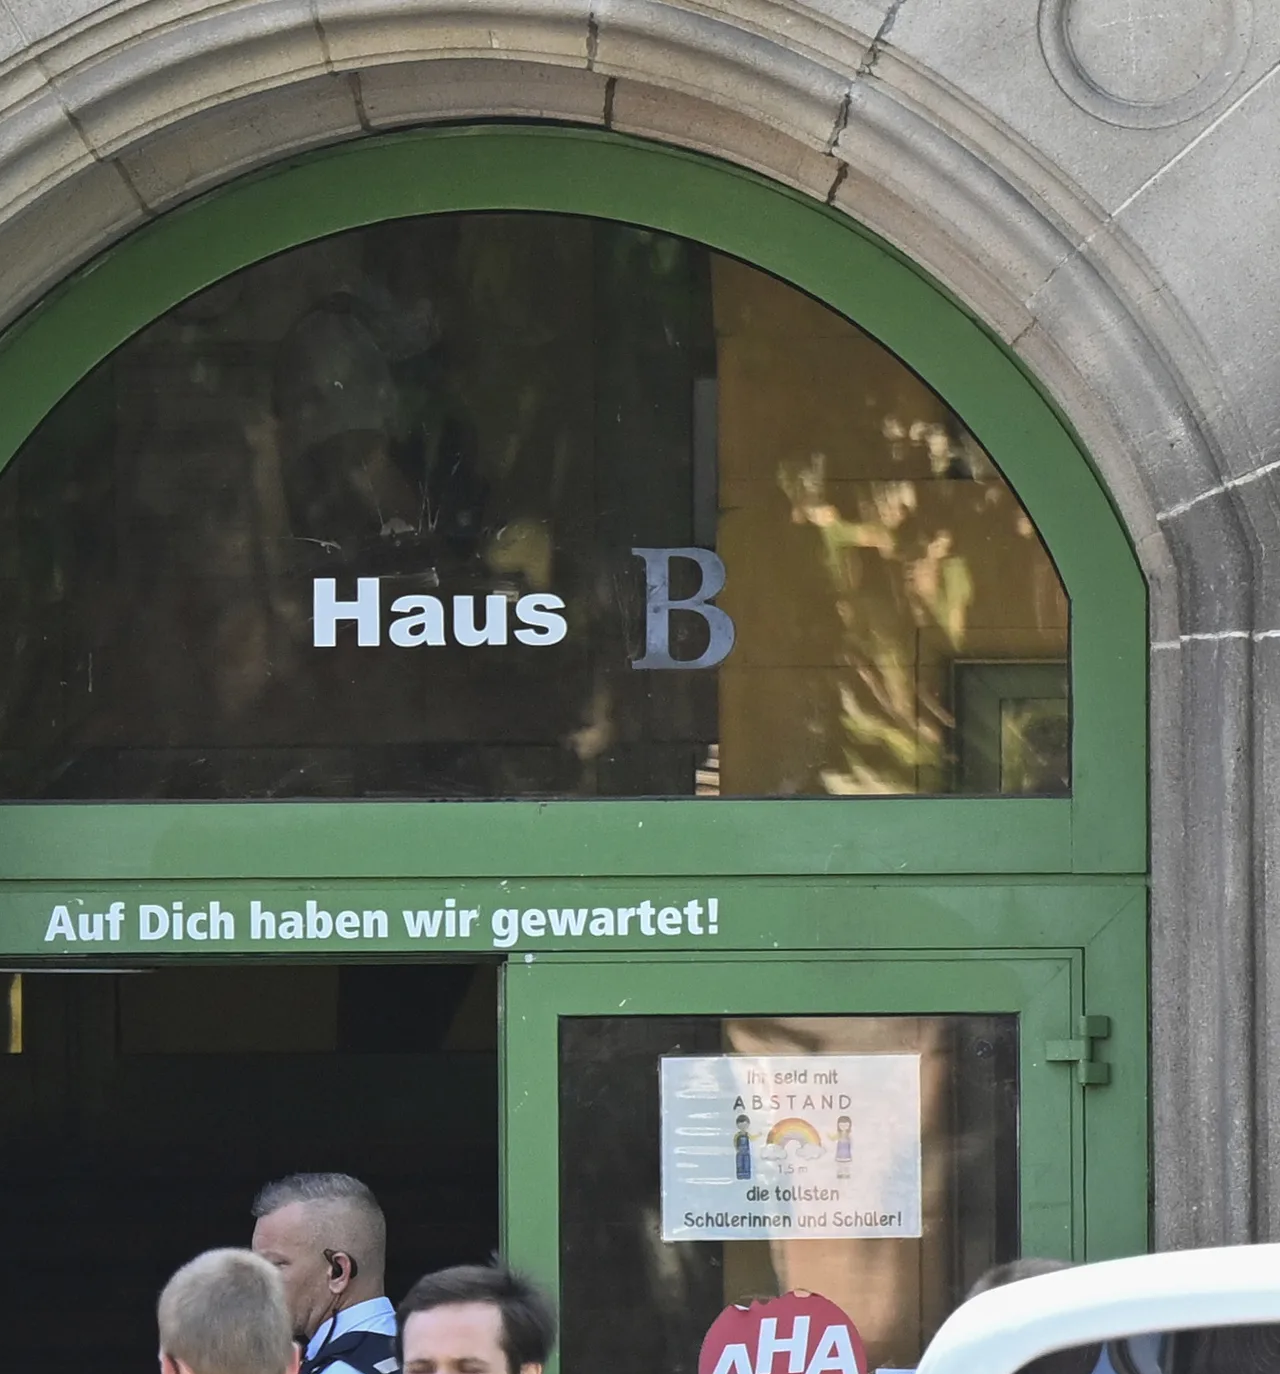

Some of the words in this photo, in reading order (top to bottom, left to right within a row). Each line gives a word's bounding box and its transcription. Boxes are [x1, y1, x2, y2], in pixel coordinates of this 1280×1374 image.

[312, 576, 568, 648] Haus
[630, 546, 736, 670] B
[44, 902, 126, 942] Auf
[138, 901, 235, 942] Dich
[250, 899, 387, 941] haben
[402, 898, 482, 939] wir
[491, 898, 720, 948] gewartet!
[746, 1069, 765, 1085] Ihr
[774, 1068, 808, 1085] seid
[813, 1068, 839, 1085] mit
[733, 1094, 851, 1110] ABSTAND
[746, 1185, 770, 1202] die
[775, 1185, 839, 1202] tollsten
[683, 1211, 792, 1228] Schülerinnen
[797, 1211, 827, 1228] und
[832, 1211, 903, 1228] Schüler!
